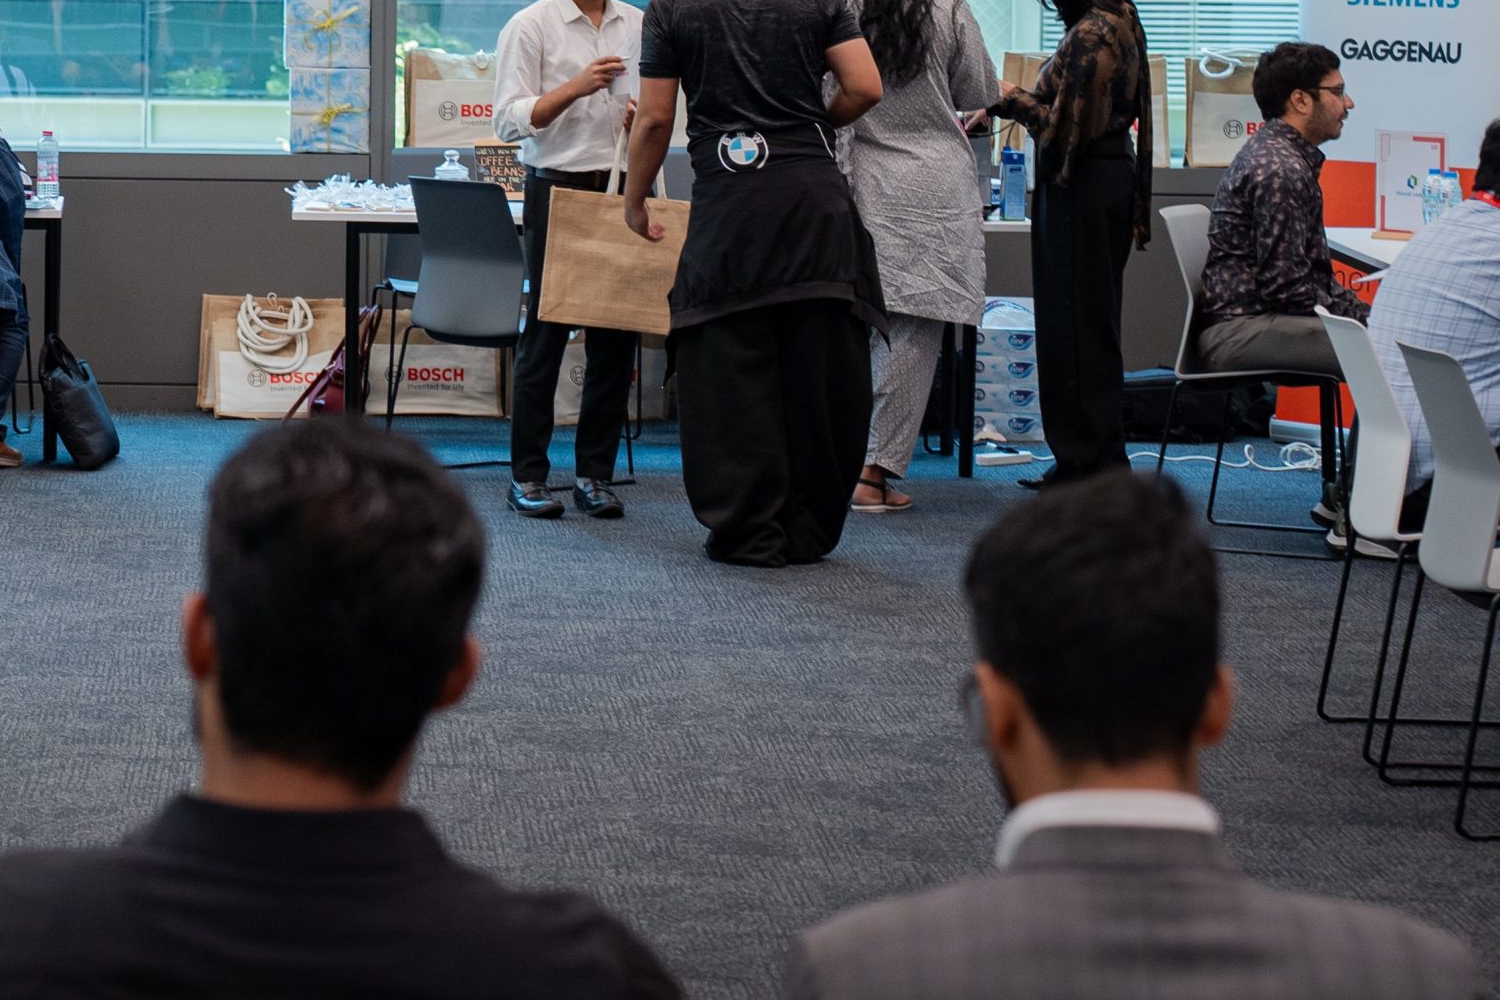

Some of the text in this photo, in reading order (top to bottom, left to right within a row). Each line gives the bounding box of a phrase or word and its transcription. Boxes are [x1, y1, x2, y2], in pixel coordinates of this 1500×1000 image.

[1340, 38, 1462, 64] GAGGENAU
[460, 104, 493, 117] BOS
[490, 166, 527, 177] BEANS
[269, 371, 322, 384] BOSC
[407, 368, 464, 381] BOSCH
